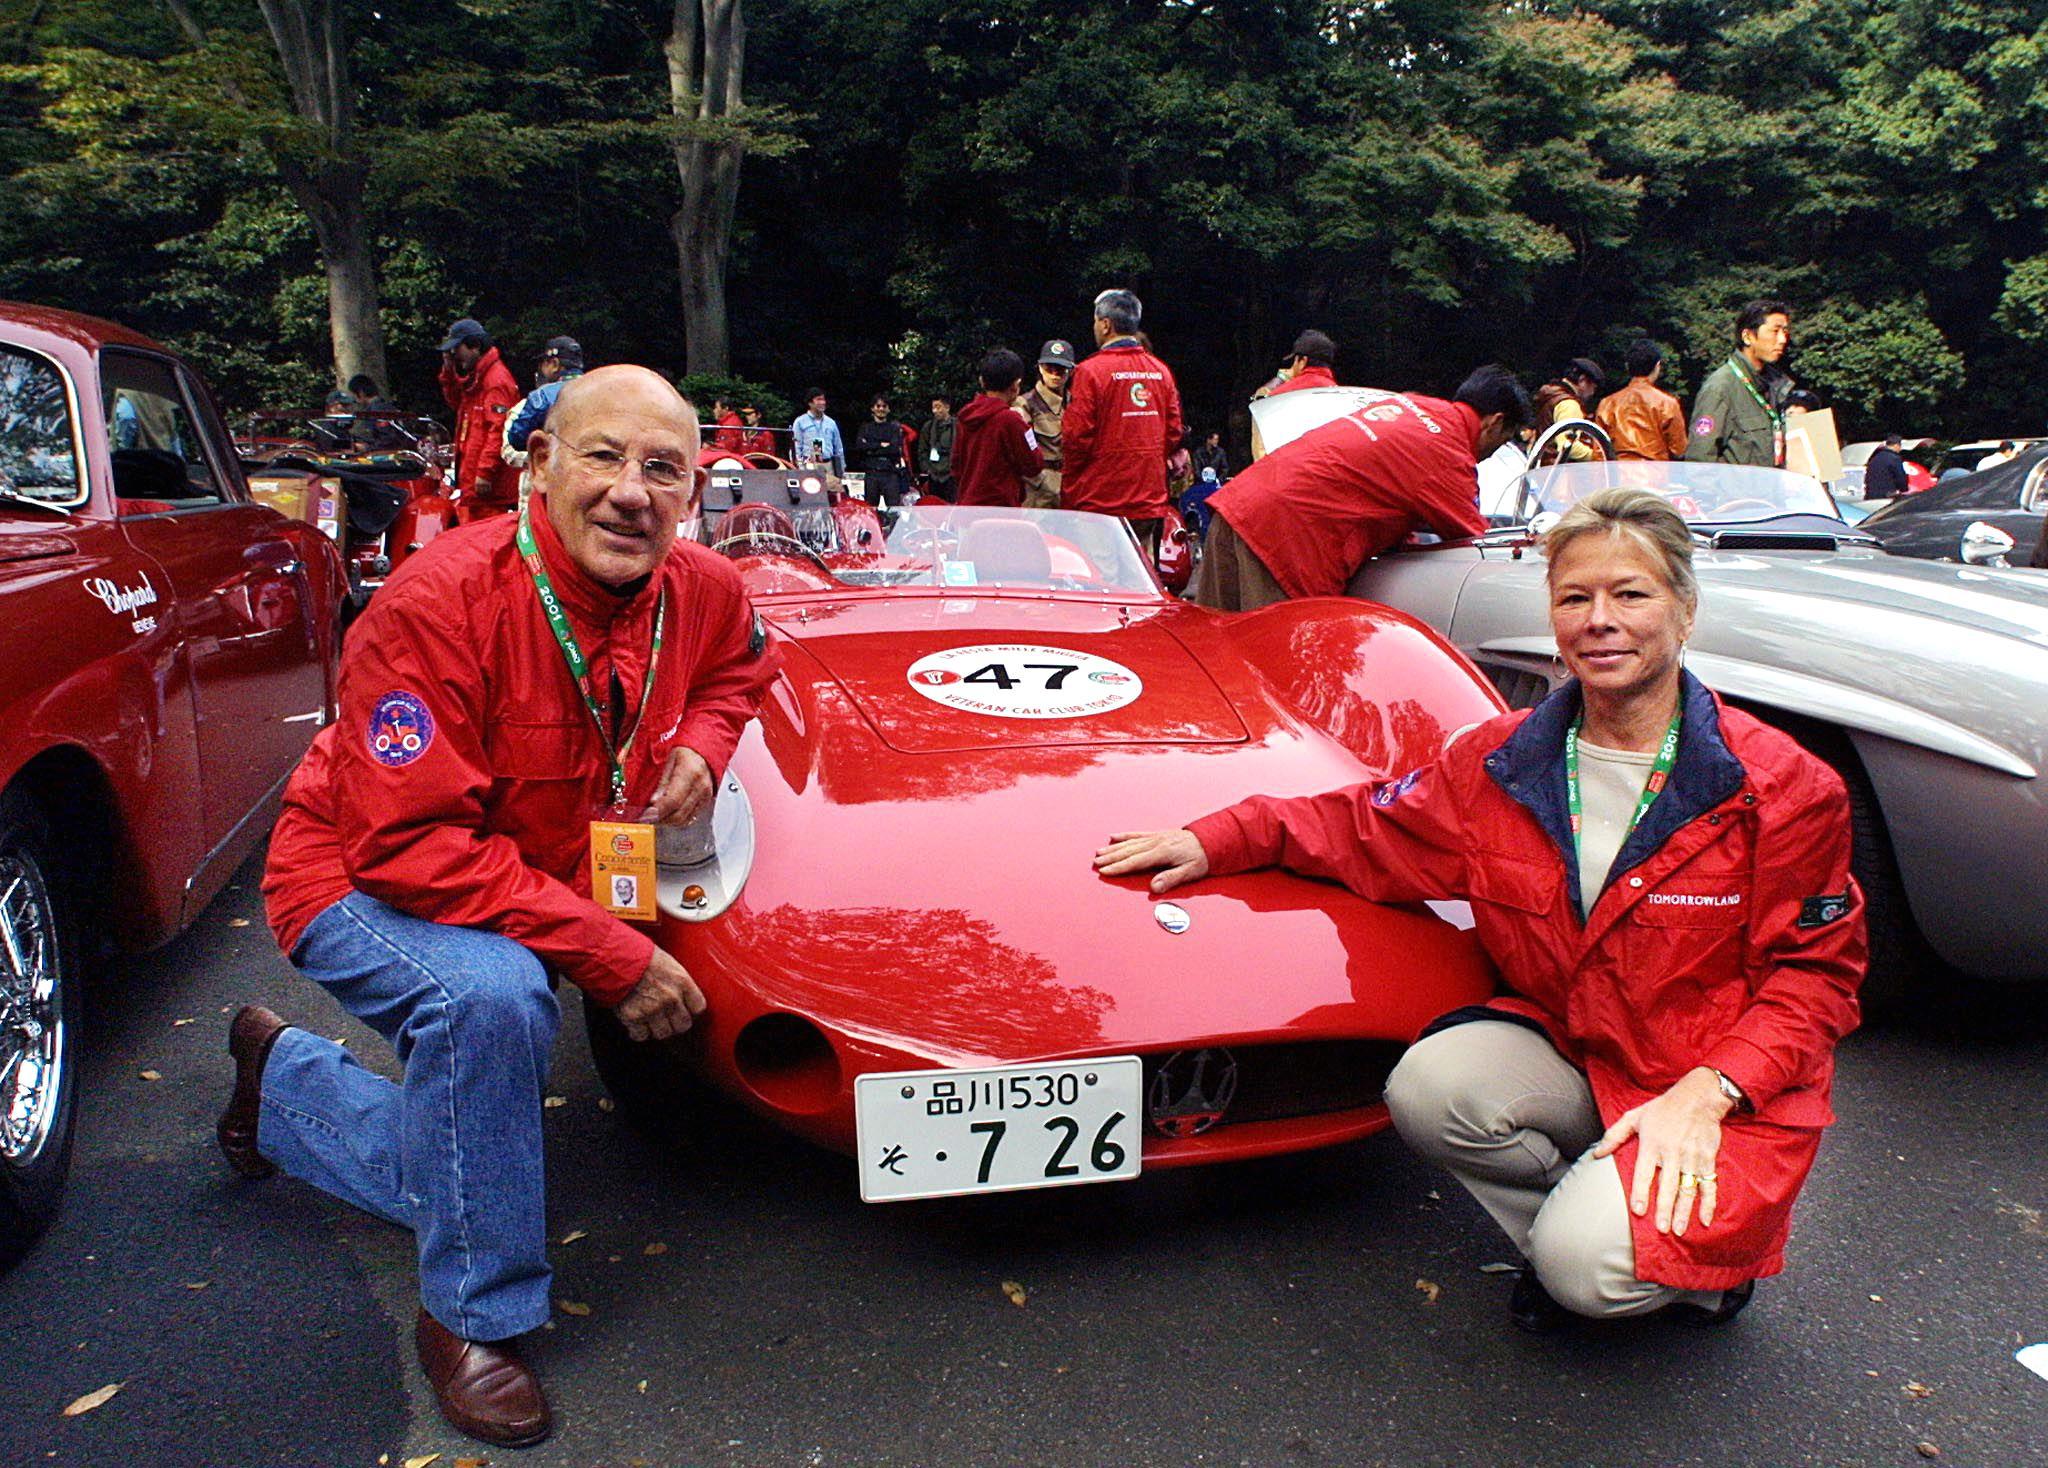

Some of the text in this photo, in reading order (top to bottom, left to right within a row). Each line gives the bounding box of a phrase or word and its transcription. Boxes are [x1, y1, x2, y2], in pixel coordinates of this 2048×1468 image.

[82, 569, 157, 619] Chopard
[539, 586, 563, 622] 2001
[963, 663, 1080, 690] 47
[944, 693, 1007, 713] VETERAN
[1011, 706, 1042, 716] CAR
[1048, 705, 1086, 715] CLUB
[1659, 728, 1679, 761] 2001
[1647, 893, 1741, 907] TOMORROWLAND
[926, 1072, 1079, 1116] 品川530
[877, 1143, 909, 1176] そ
